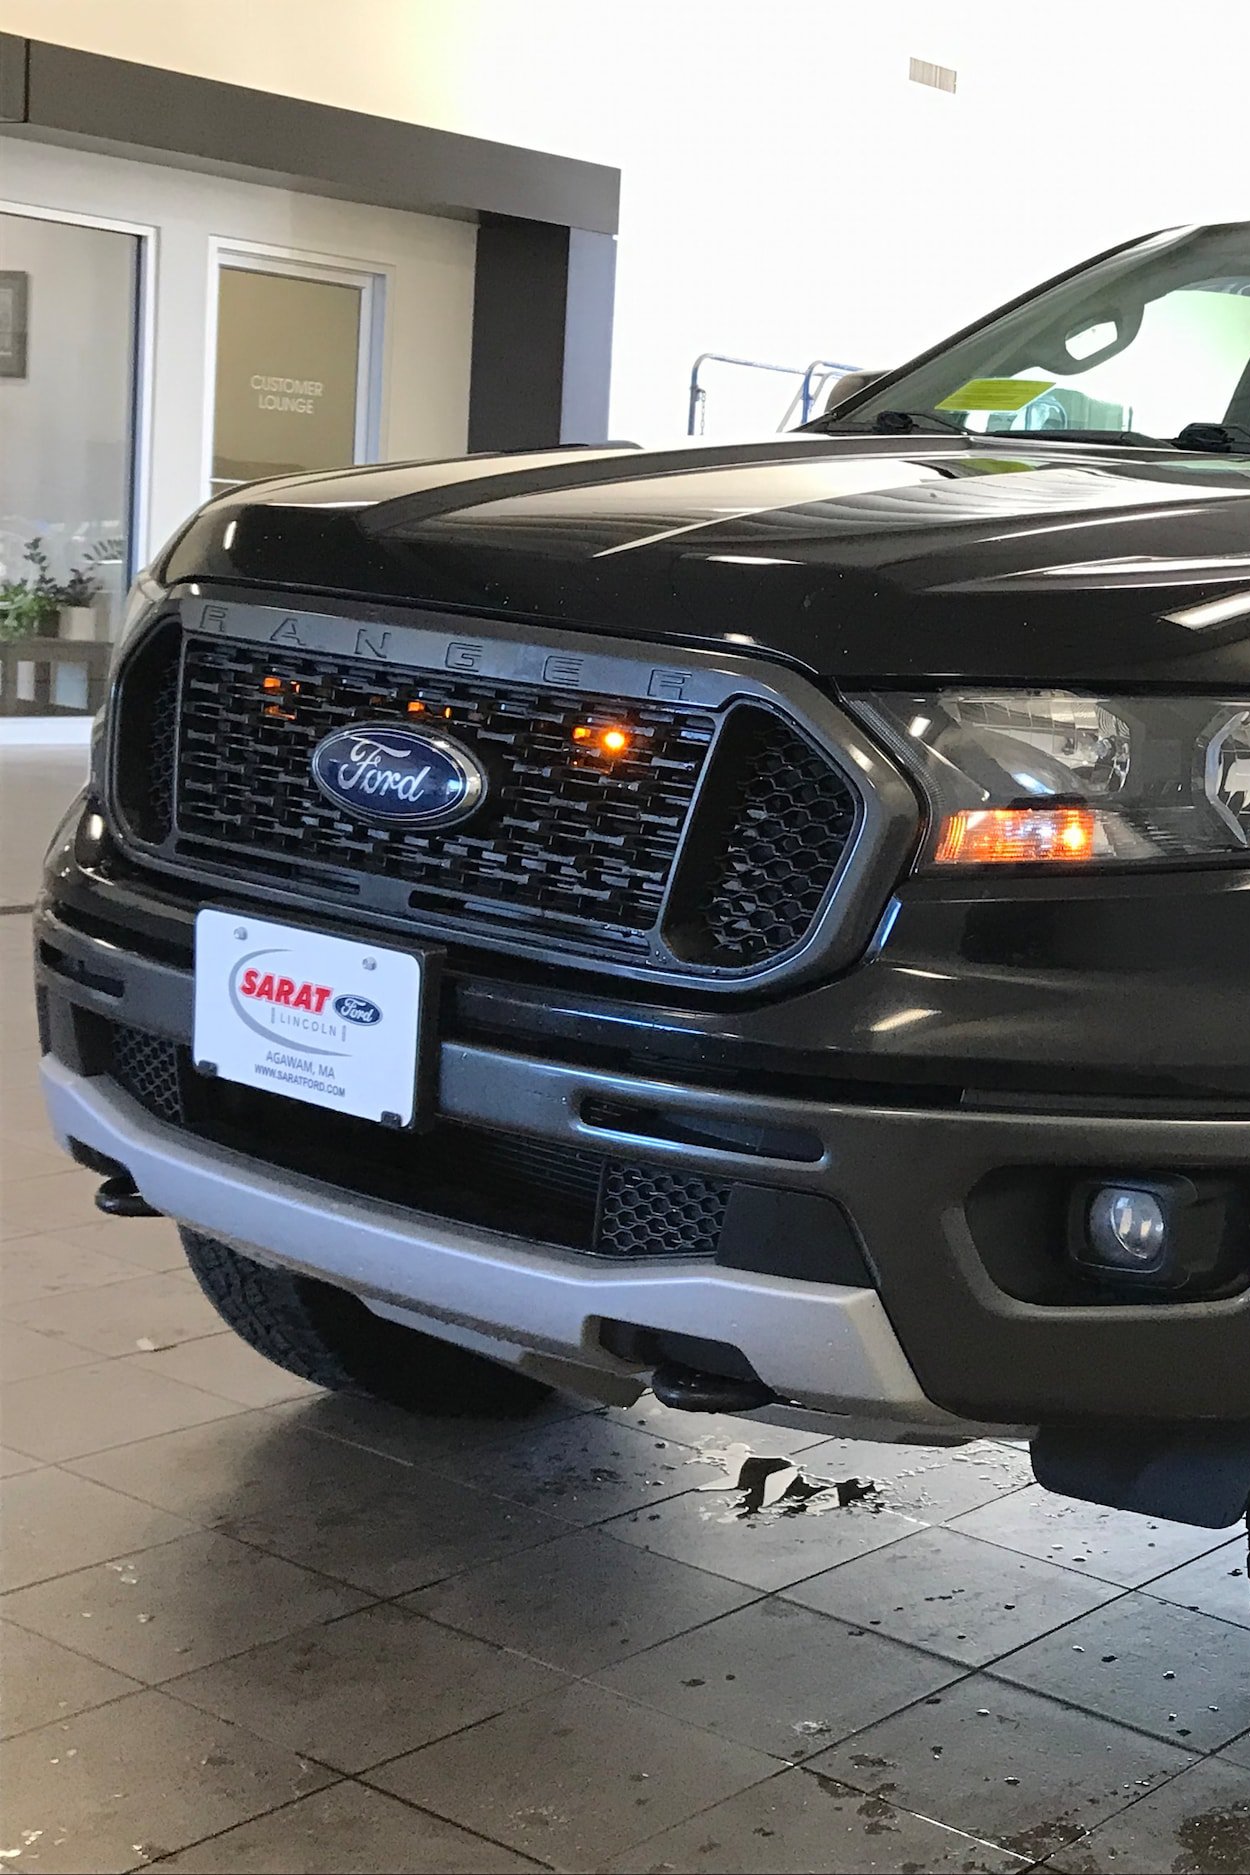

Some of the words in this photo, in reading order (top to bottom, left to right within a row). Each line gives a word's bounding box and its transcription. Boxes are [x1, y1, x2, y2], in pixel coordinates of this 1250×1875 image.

[250, 375, 324, 396] CUSTOMER
[258, 395, 314, 414] LOUNGE
[200, 604, 693, 702] RANGER
[339, 737, 426, 803] Ford
[240, 968, 332, 1013] SARAT
[340, 997, 375, 1023] Ford
[280, 1014, 337, 1037] LINCOLN
[254, 1063, 346, 1098] WWW.SARATFORD.COM
[266, 1051, 315, 1075] AGAWAM,
[318, 1064, 335, 1079] MA
